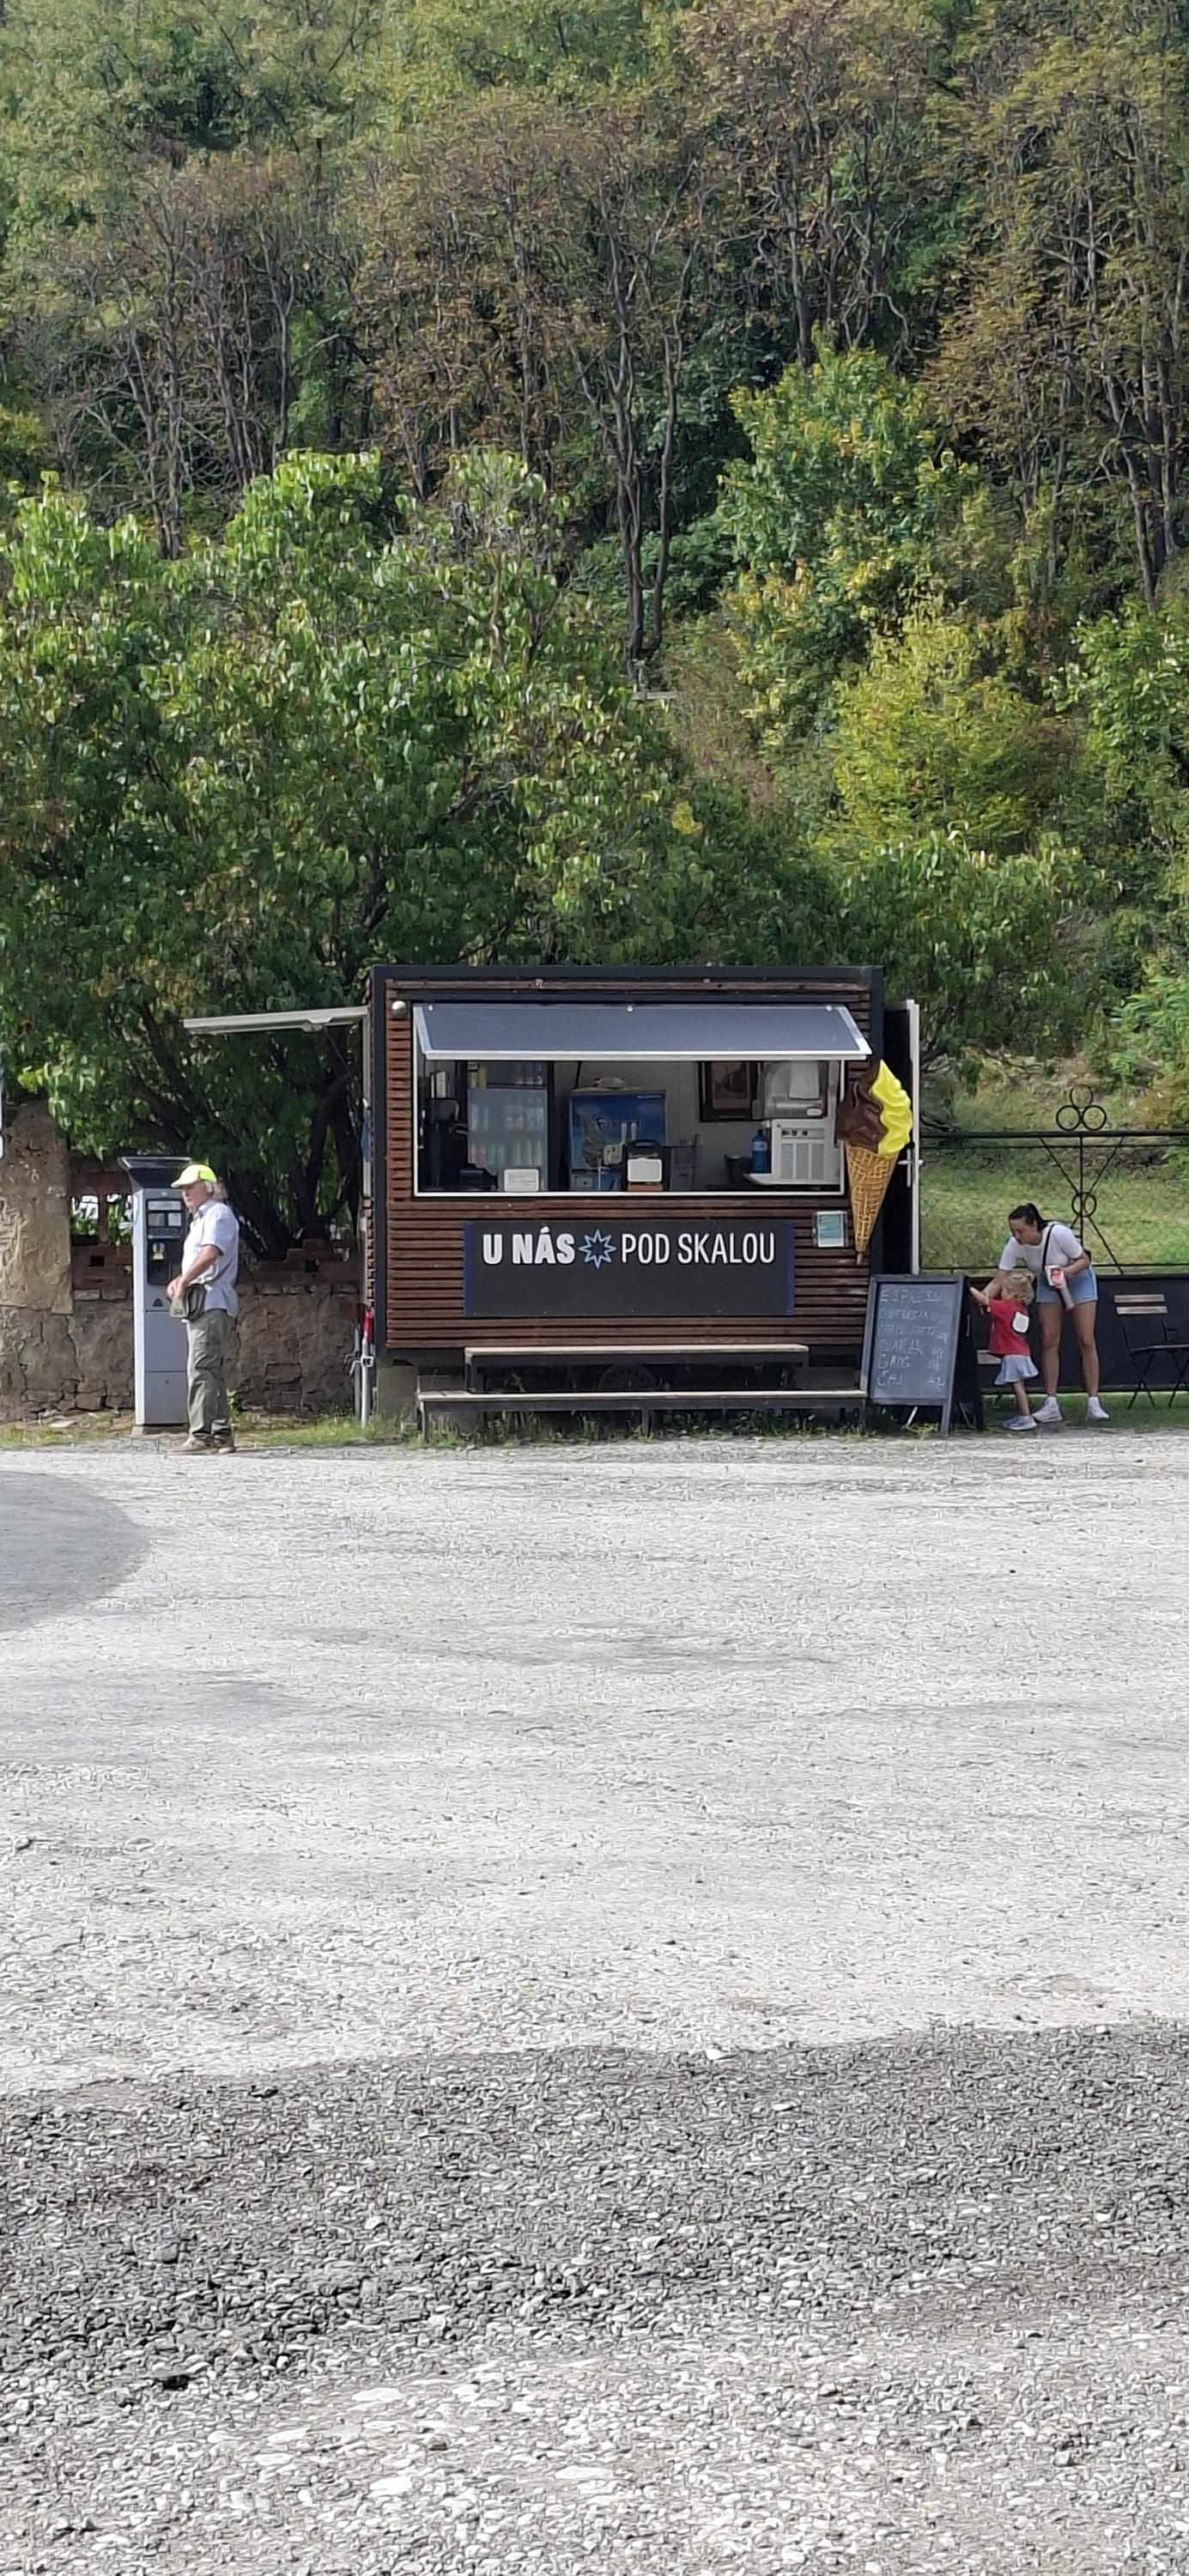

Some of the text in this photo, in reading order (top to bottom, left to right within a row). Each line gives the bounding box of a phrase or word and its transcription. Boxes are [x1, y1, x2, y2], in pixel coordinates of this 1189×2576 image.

[482, 1227, 775, 1264] U NÁS POD SKALOU
